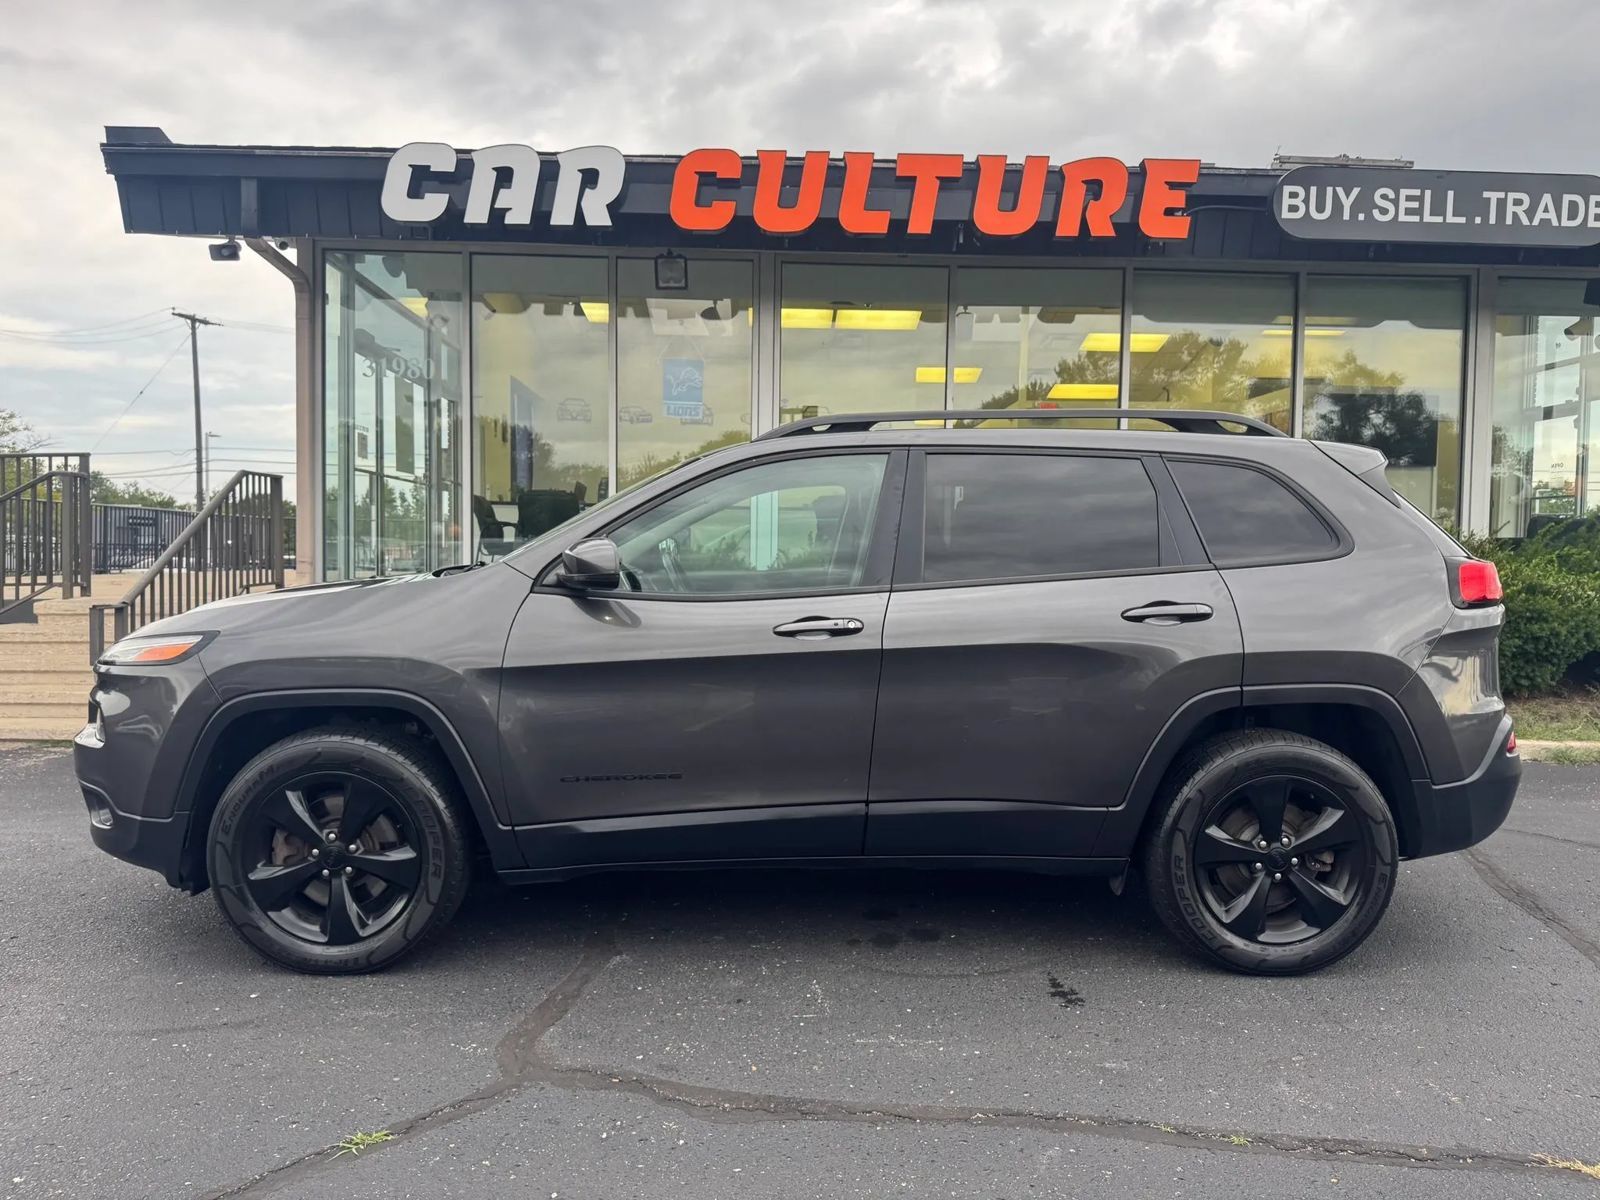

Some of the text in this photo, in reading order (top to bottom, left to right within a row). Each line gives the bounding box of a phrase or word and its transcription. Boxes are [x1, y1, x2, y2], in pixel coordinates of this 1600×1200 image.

[380, 142, 1200, 238] CAR CULTURE
[362, 357, 435, 379] 31980
